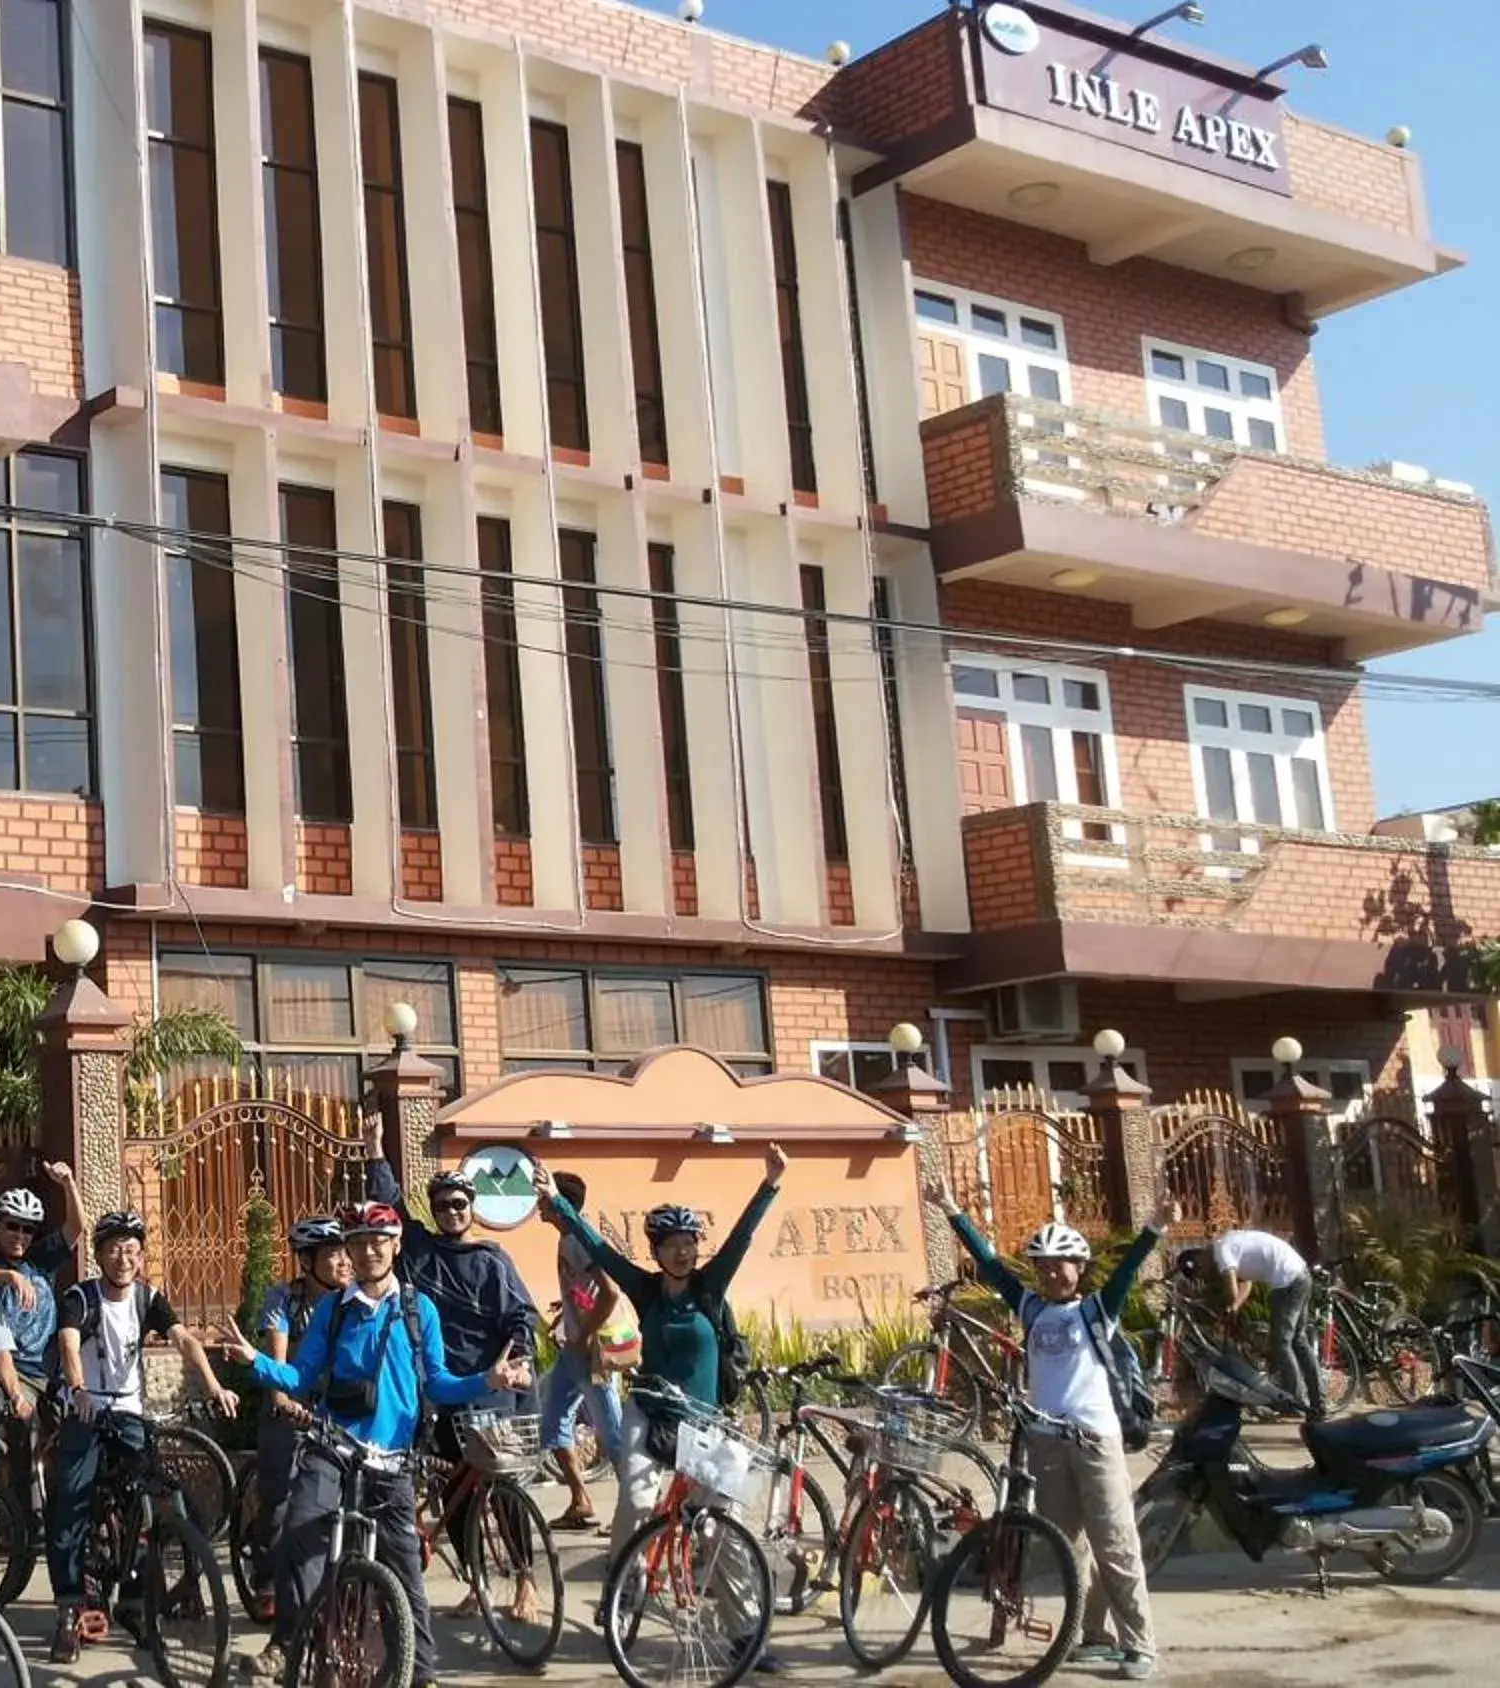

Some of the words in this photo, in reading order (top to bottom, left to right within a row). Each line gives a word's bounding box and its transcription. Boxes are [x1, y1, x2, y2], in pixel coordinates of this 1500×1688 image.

[1048, 62, 1161, 134] INLE
[1172, 104, 1281, 172] APEX
[769, 1205, 910, 1258] APEX
